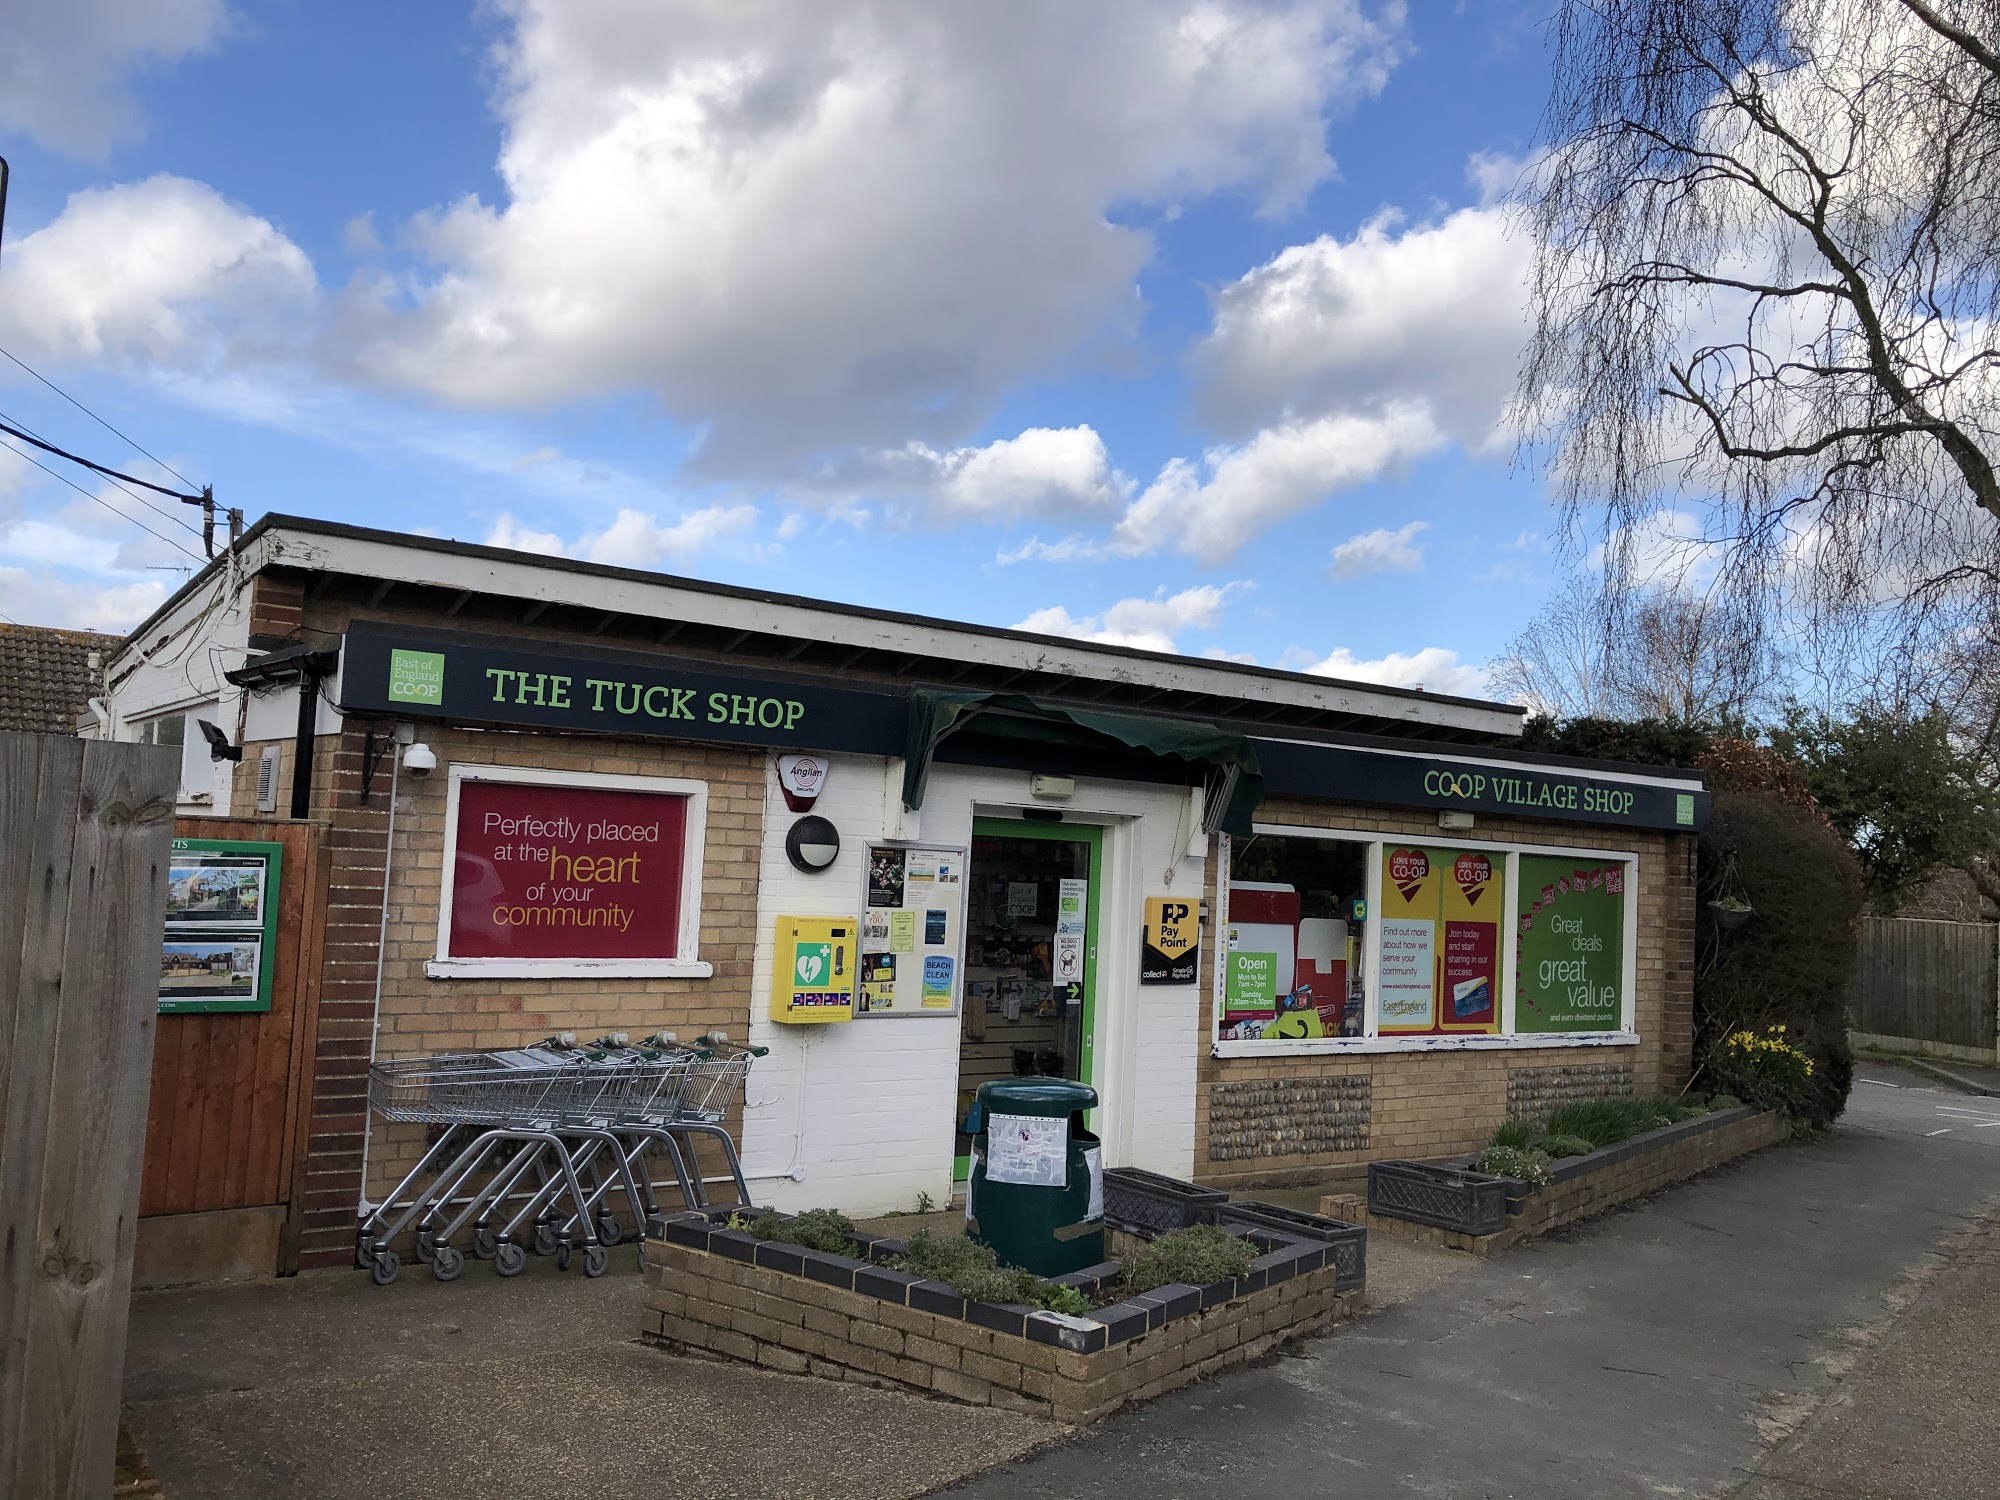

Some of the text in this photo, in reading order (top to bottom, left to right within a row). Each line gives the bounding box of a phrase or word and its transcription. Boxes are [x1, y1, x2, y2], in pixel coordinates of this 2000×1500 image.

[394, 656, 434, 670] East of
[394, 668, 440, 682] England
[486, 668, 805, 730] THE TUCK SHOP
[790, 766, 822, 778] Anglian
[1492, 778, 1578, 810] VILLAGE
[1583, 790, 1634, 814] SHOP
[484, 812, 659, 844] Perfectly placed
[494, 842, 642, 884] at the heart
[1394, 856, 1426, 866] LOVE YOUR
[1458, 861, 1488, 870] LOVE YOUR
[1393, 865, 1426, 878] CO-OP
[1458, 870, 1488, 882] CO-OP
[1606, 872, 1617, 880] BUY
[526, 882, 594, 906] of your
[1606, 884, 1623, 894] FREE
[492, 902, 634, 932] community
[1550, 914, 1584, 934] Great
[1161, 926, 1179, 938] Pay
[1383, 926, 1398, 936] Find
[1400, 928, 1410, 936] out
[1448, 928, 1480, 940] Join today
[1160, 937, 1188, 948] Point
[1383, 940, 1402, 949] about
[1403, 940, 1417, 950] how
[1448, 942, 1475, 951] and start
[1572, 934, 1602, 952] deals
[1238, 956, 1268, 972] Open
[1382, 954, 1416, 964] serve your
[1448, 956, 1470, 966] sharing
[926, 962, 950, 970] BEACH
[1382, 966, 1418, 978] community
[926, 971, 950, 979] CLEAN
[1238, 973, 1250, 981] Mon
[1257, 973, 1266, 981] Sat
[1539, 956, 1588, 989] great
[1241, 990, 1262, 1002] Sunday
[1567, 980, 1614, 1008] value
[1383, 1000, 1397, 1012] East
[1400, 1000, 1427, 1012] England
[1550, 1014, 1561, 1022] and
[1574, 1013, 1596, 1022] dividend
[1597, 1014, 1614, 1022] points
[1322, 1022, 1341, 1036] ACK
